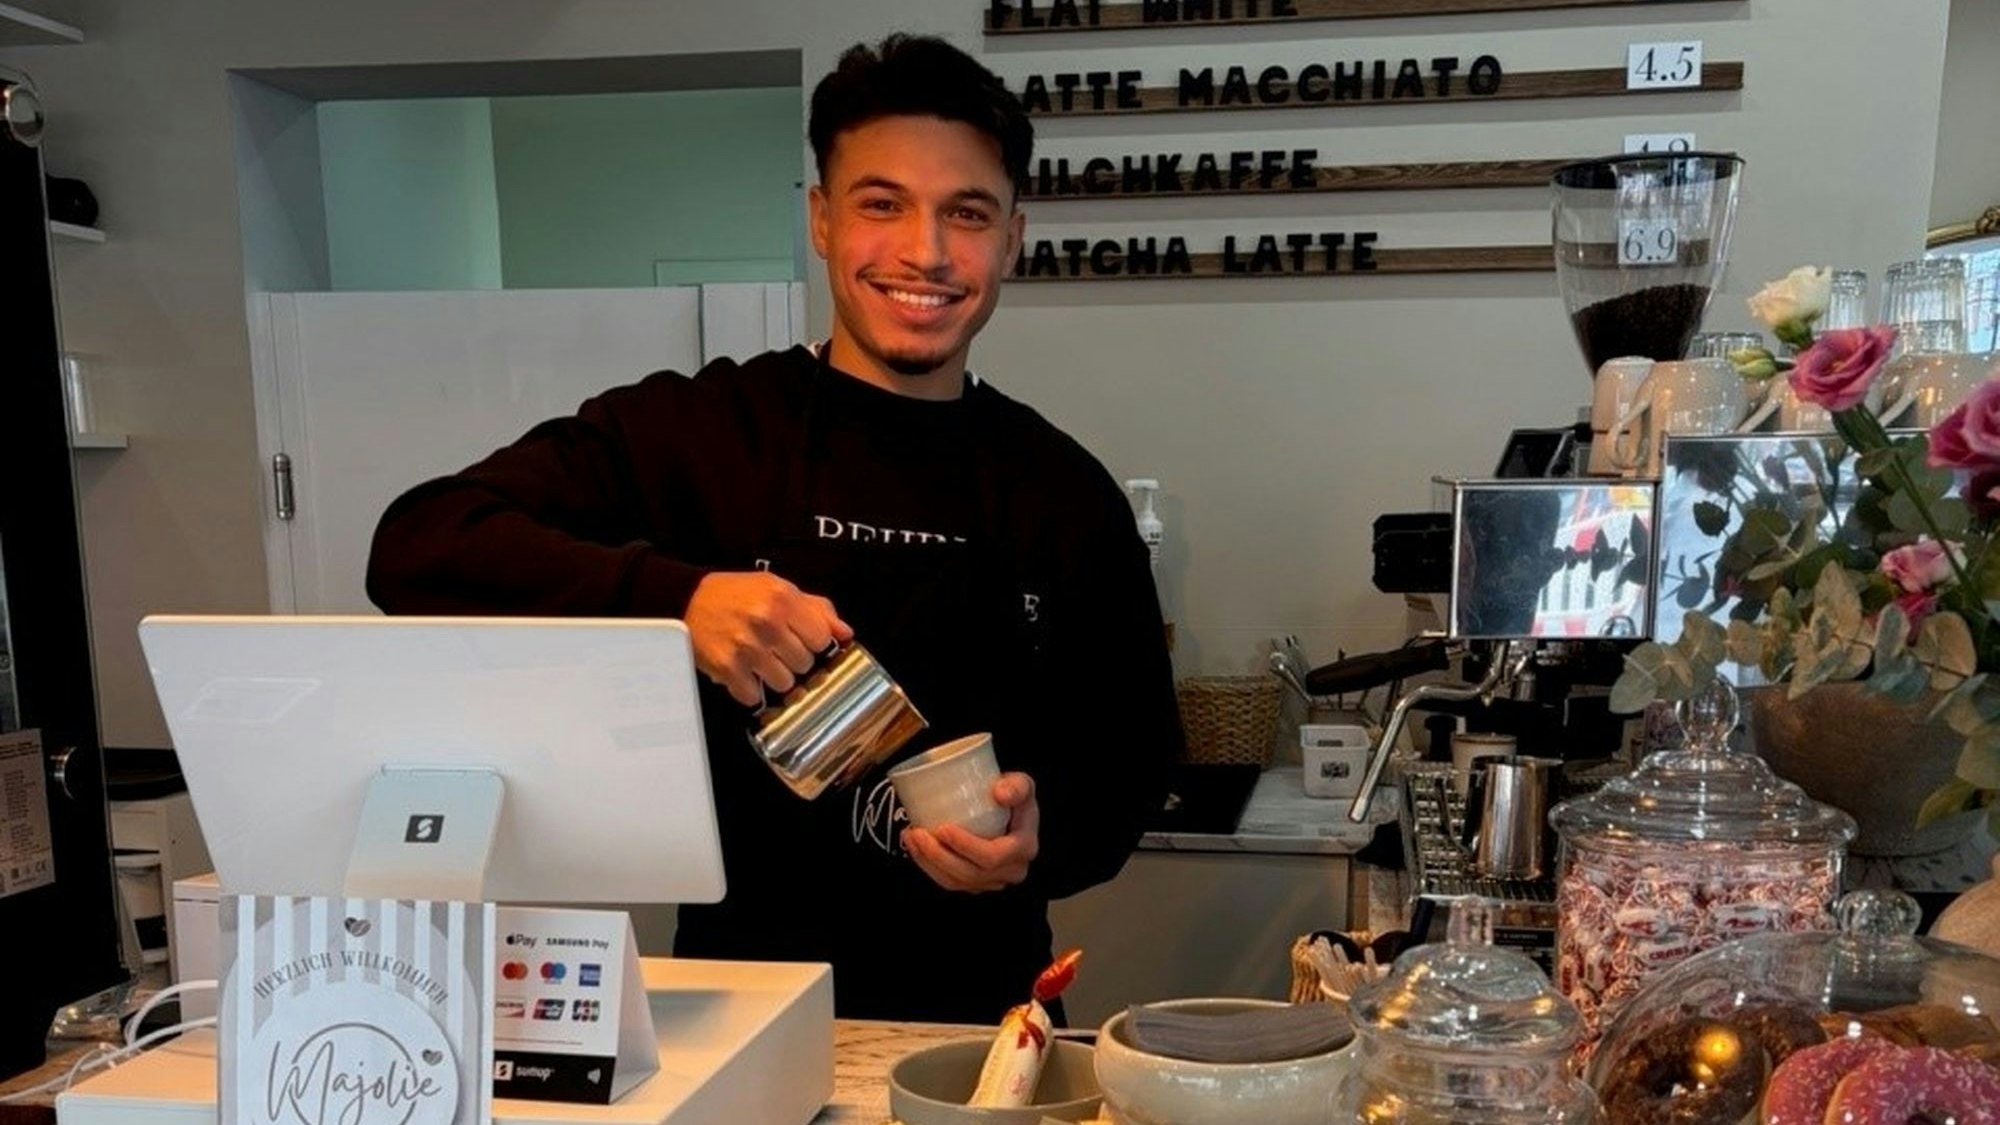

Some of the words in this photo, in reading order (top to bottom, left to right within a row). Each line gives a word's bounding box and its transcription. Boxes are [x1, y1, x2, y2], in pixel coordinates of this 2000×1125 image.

[1000, 71, 1142, 113] ATTE
[1179, 55, 1502, 106] MACCHIATO
[1635, 46, 1695, 83] 4.5
[1224, 232, 1378, 273] LATTE
[1624, 227, 1676, 262] 6.9
[253, 952, 332, 999] HERZLICH
[340, 950, 449, 1005] WILLKOMMEN
[267, 1040, 442, 1125] Majolie
